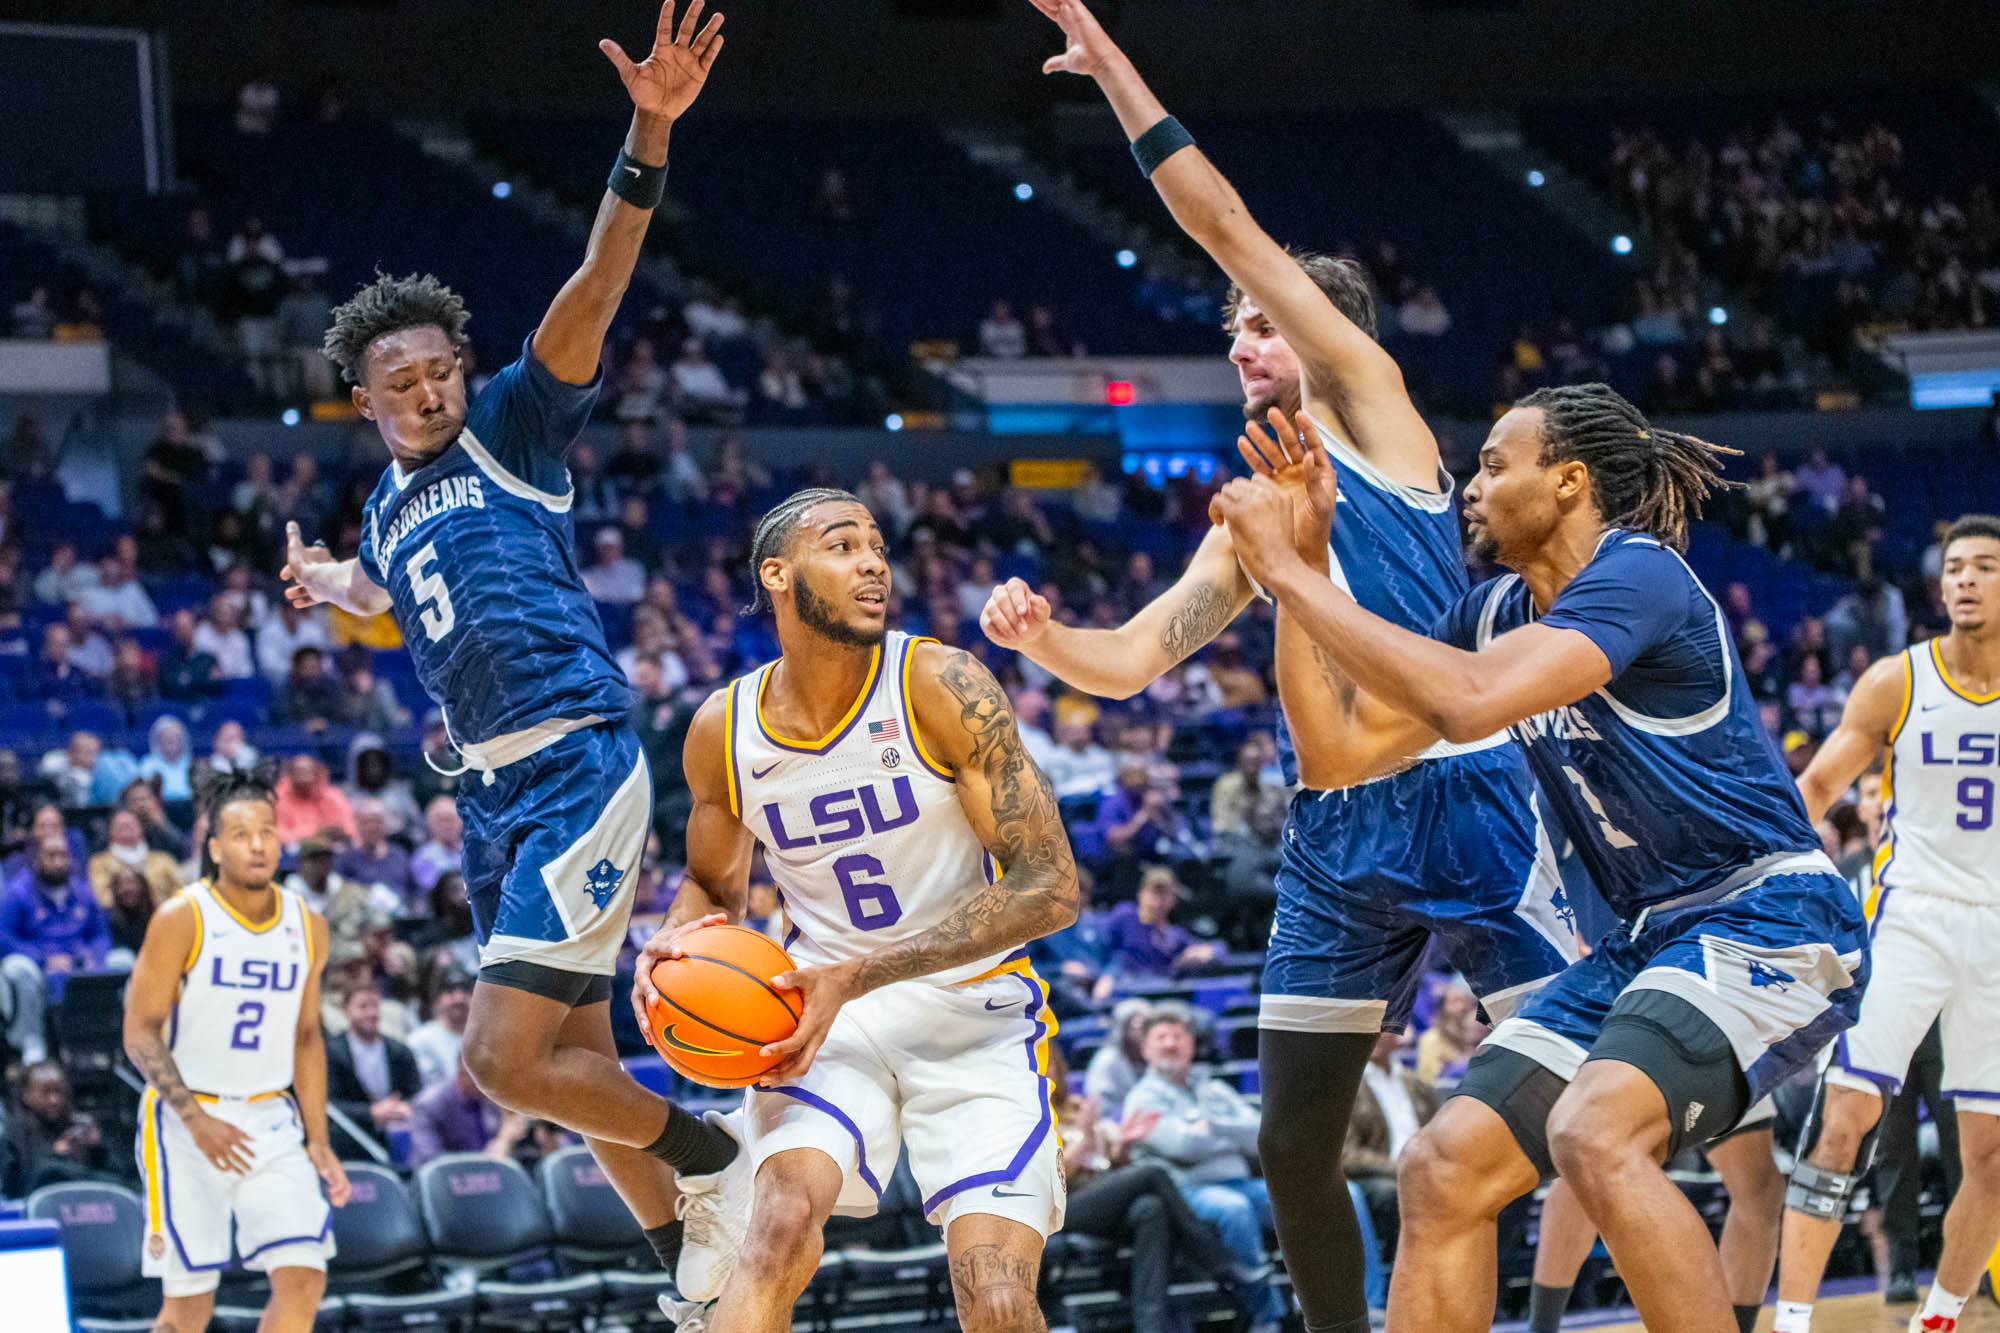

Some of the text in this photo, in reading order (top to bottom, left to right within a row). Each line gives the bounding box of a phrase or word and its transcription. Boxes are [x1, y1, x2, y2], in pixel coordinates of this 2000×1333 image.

[400, 476, 485, 540] ORLEANS
[406, 541, 455, 643] 5
[1921, 731, 2000, 767] LS
[762, 775, 920, 850] LSU
[1956, 777, 1995, 831] 9
[832, 853, 903, 931] 6
[211, 957, 298, 991] LSU
[230, 1001, 265, 1050] 2
